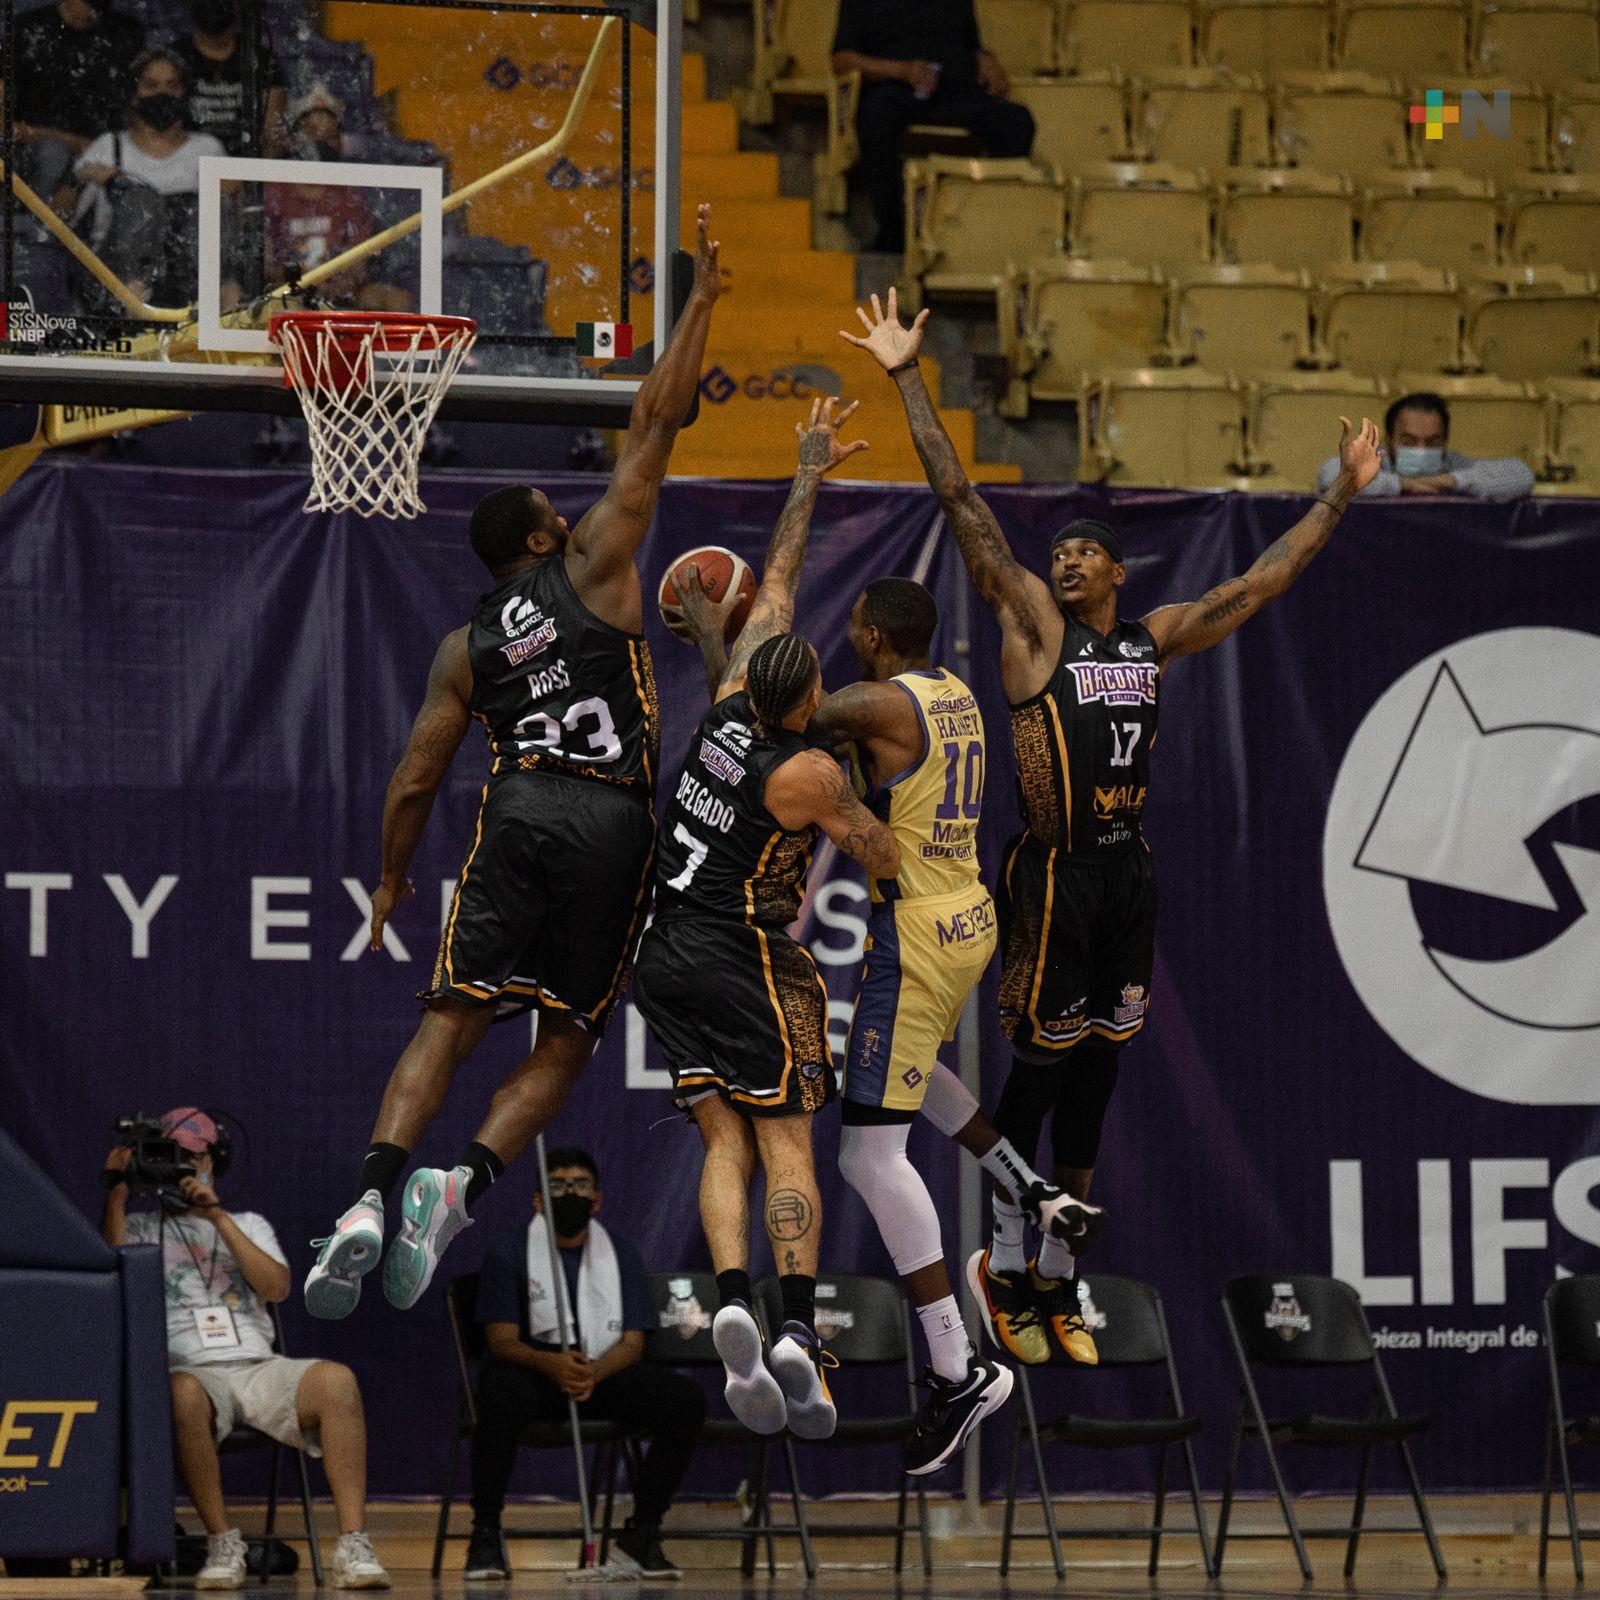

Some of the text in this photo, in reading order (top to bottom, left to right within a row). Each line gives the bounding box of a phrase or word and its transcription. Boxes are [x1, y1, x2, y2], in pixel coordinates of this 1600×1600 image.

[8, 302, 30, 310] LIGA
[9, 328, 46, 342] LNBP
[527, 658, 571, 700] ROSS
[513, 696, 623, 763] 23
[713, 730, 749, 760] Grumax
[935, 713, 981, 740] HANEY
[1110, 722, 1142, 767] 17
[935, 740, 983, 819] 10
[675, 770, 736, 834] DELGADO
[666, 821, 709, 892] 7
[922, 845, 973, 859] BUD IGHT
[1426, 1325, 1506, 1353] Integral
[1509, 1325, 1539, 1349] de
[0, 1400, 99, 1468] ET
